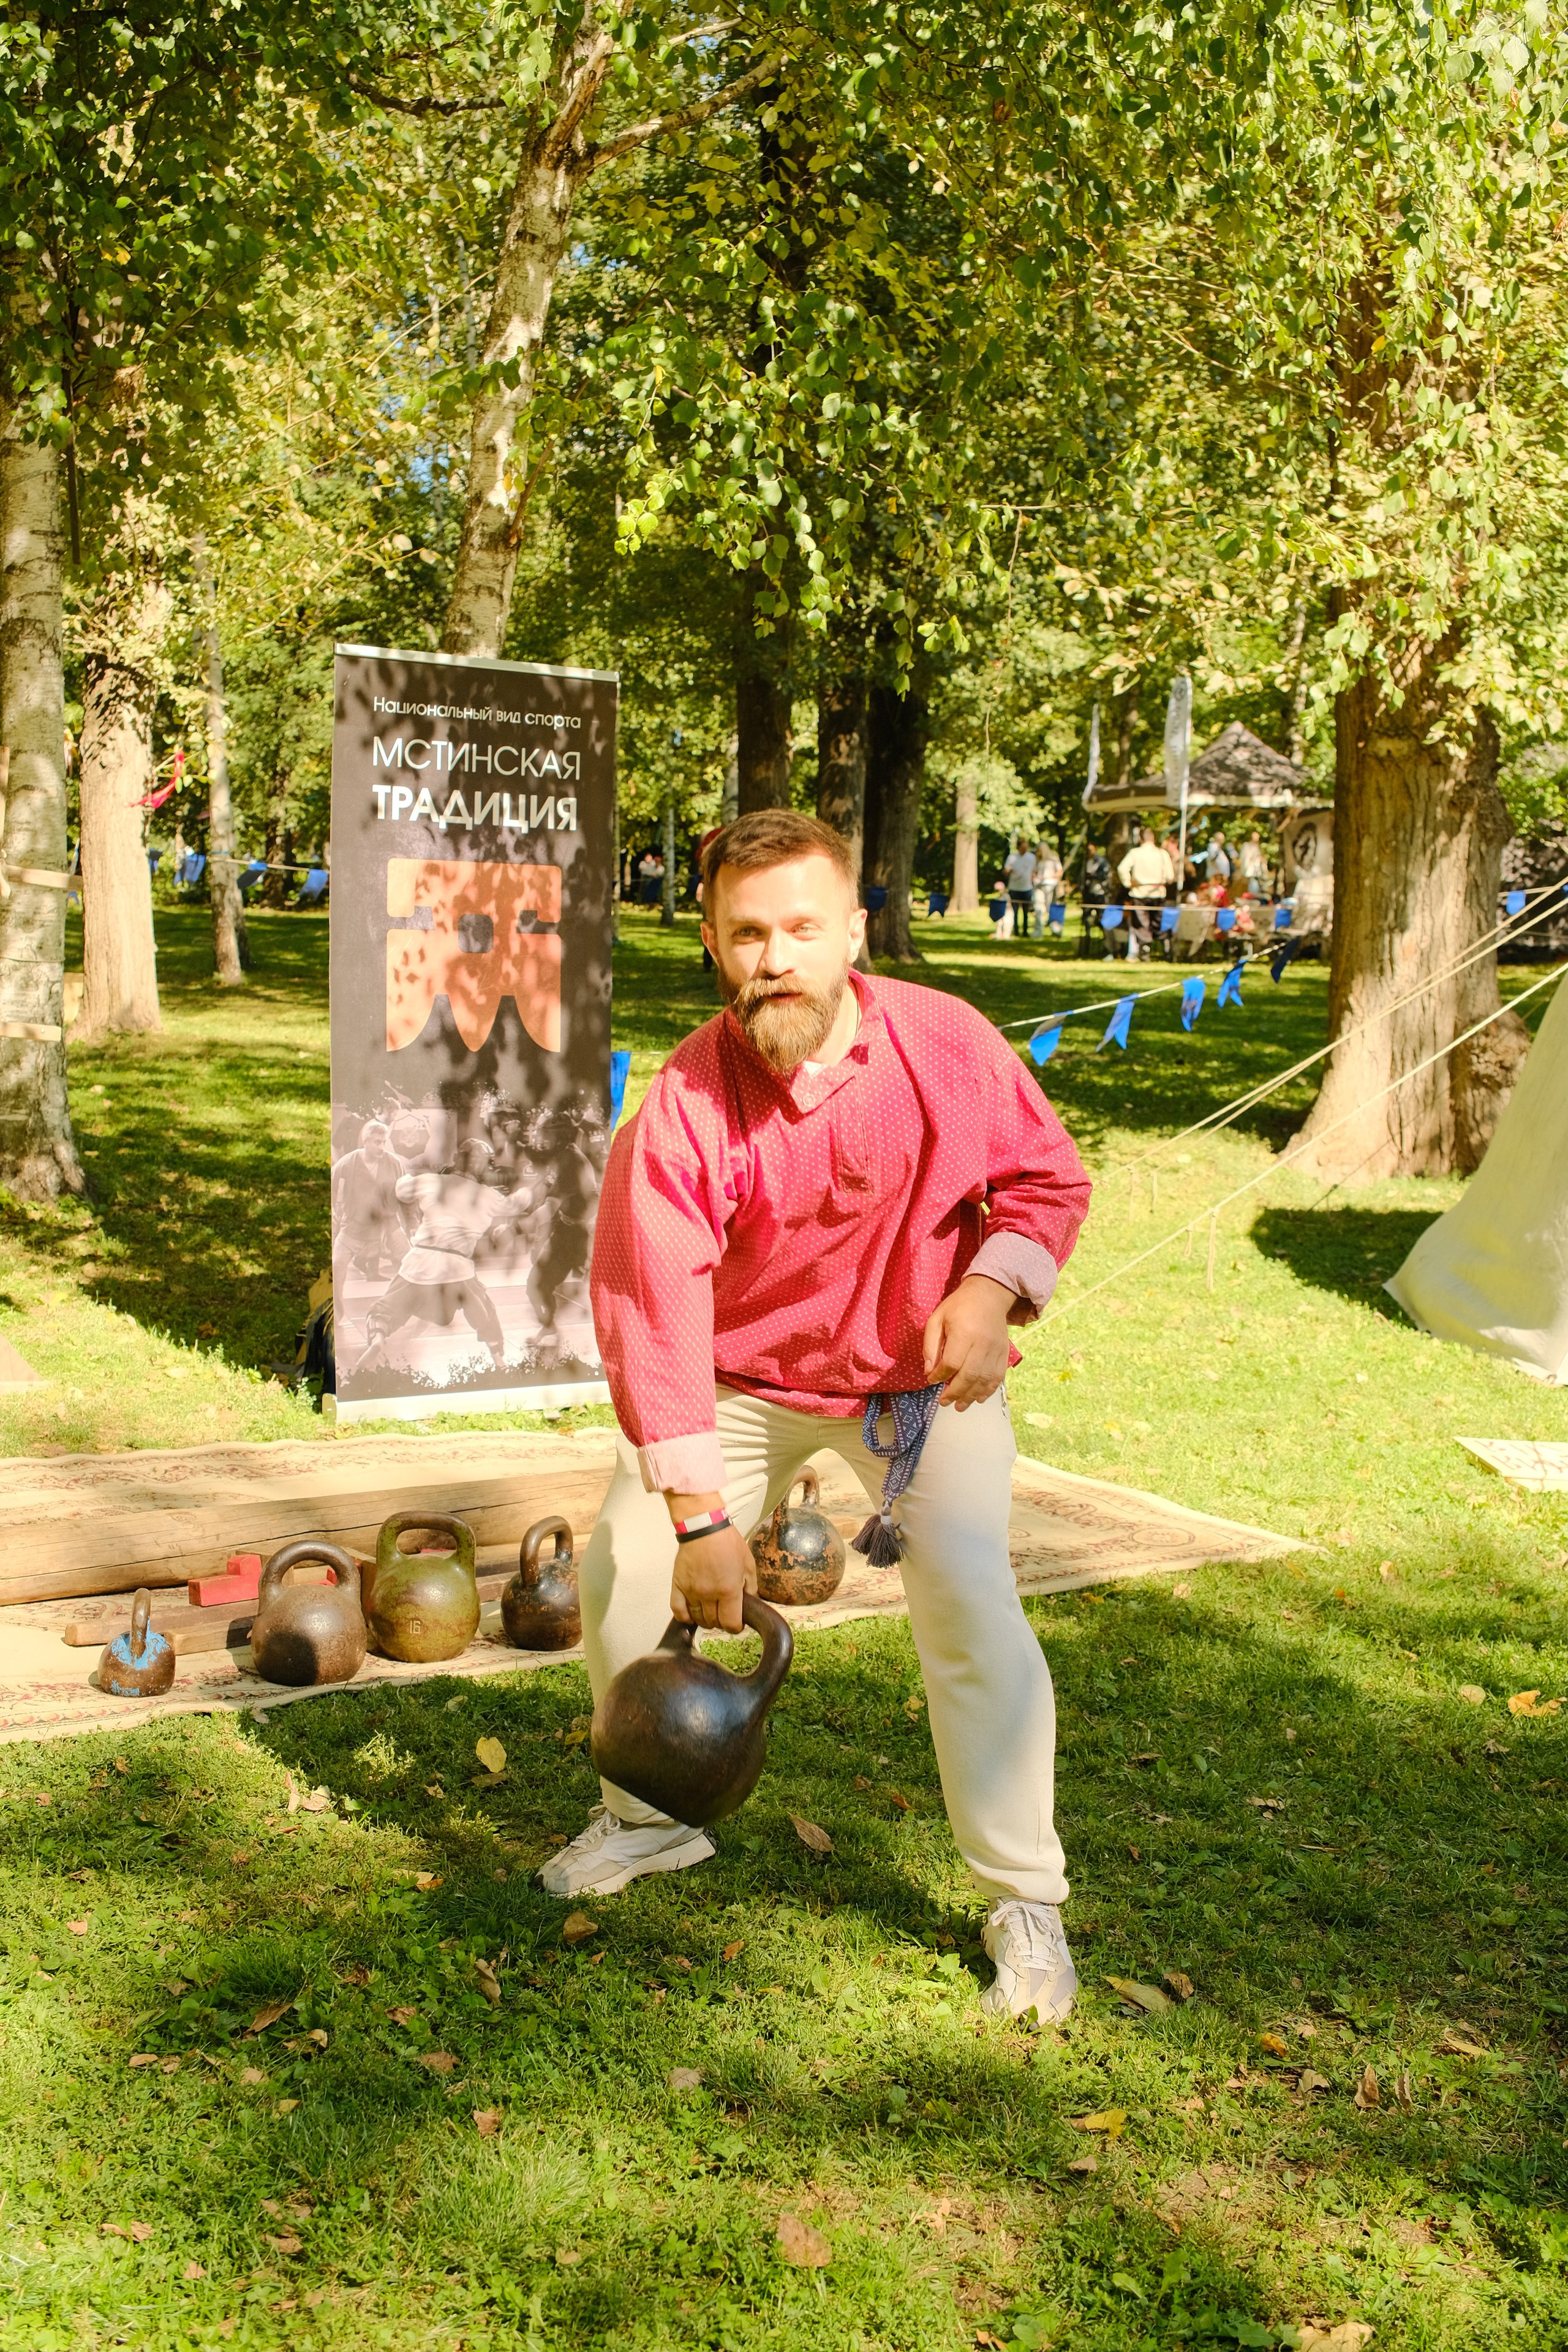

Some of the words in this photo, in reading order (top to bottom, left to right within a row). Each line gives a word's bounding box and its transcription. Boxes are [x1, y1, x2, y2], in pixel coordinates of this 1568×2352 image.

[373, 696, 492, 721] Национальный
[496, 710, 521, 724] вид
[524, 712, 581, 730] спорта
[372, 736, 581, 781] МСТИНСКАЯ
[371, 784, 578, 834] ТРАДИЦИЯ
[409, 1620, 421, 1634] 16
